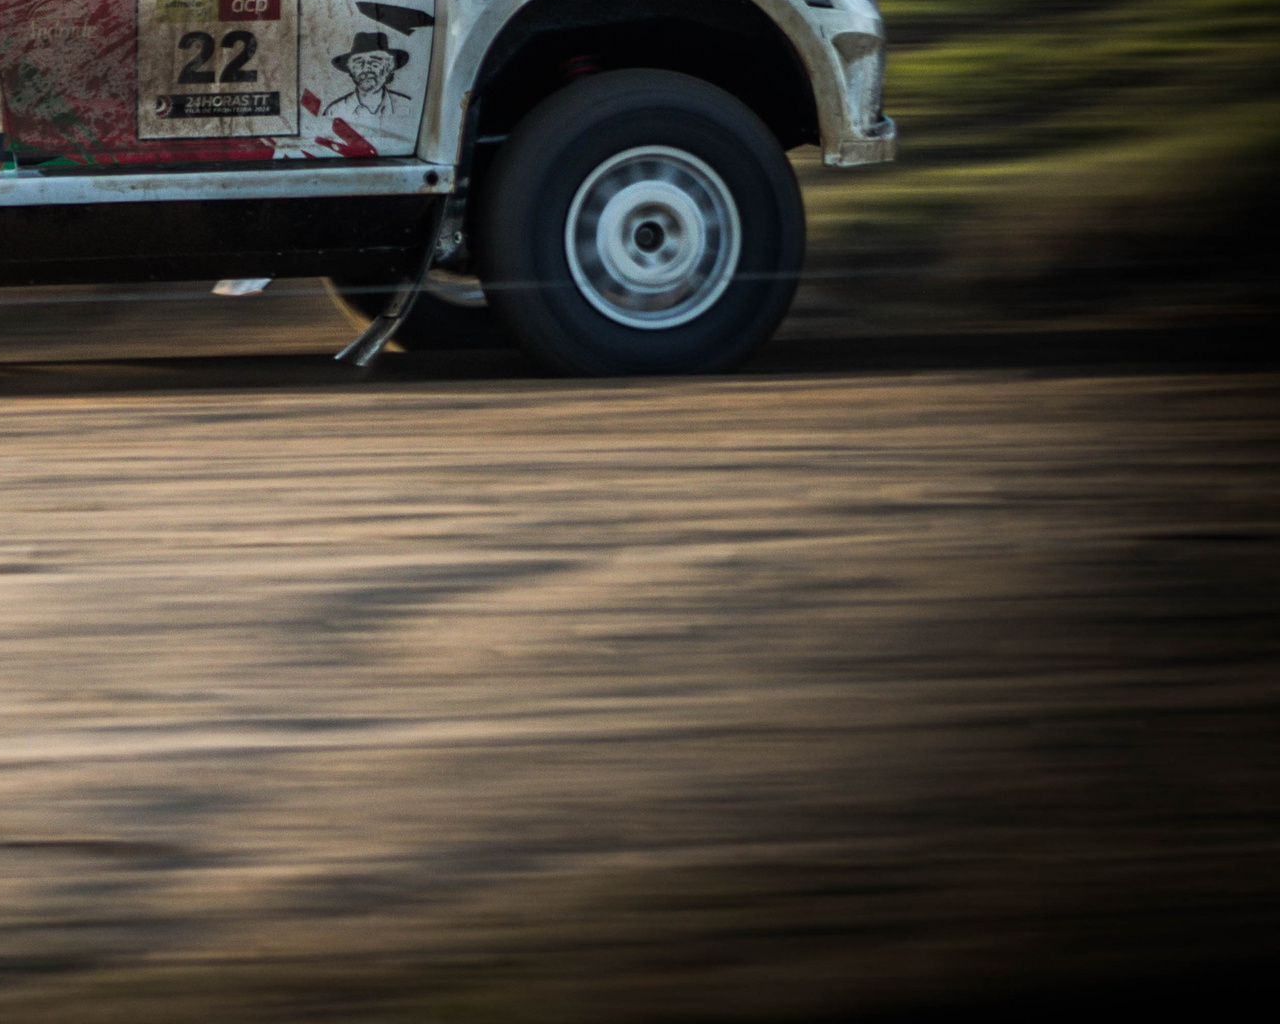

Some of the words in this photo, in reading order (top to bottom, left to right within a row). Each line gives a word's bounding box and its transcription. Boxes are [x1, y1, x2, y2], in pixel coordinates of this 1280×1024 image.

[177, 30, 258, 85] 22
[185, 95, 250, 108] 24HORAS
[252, 94, 271, 106] TT
